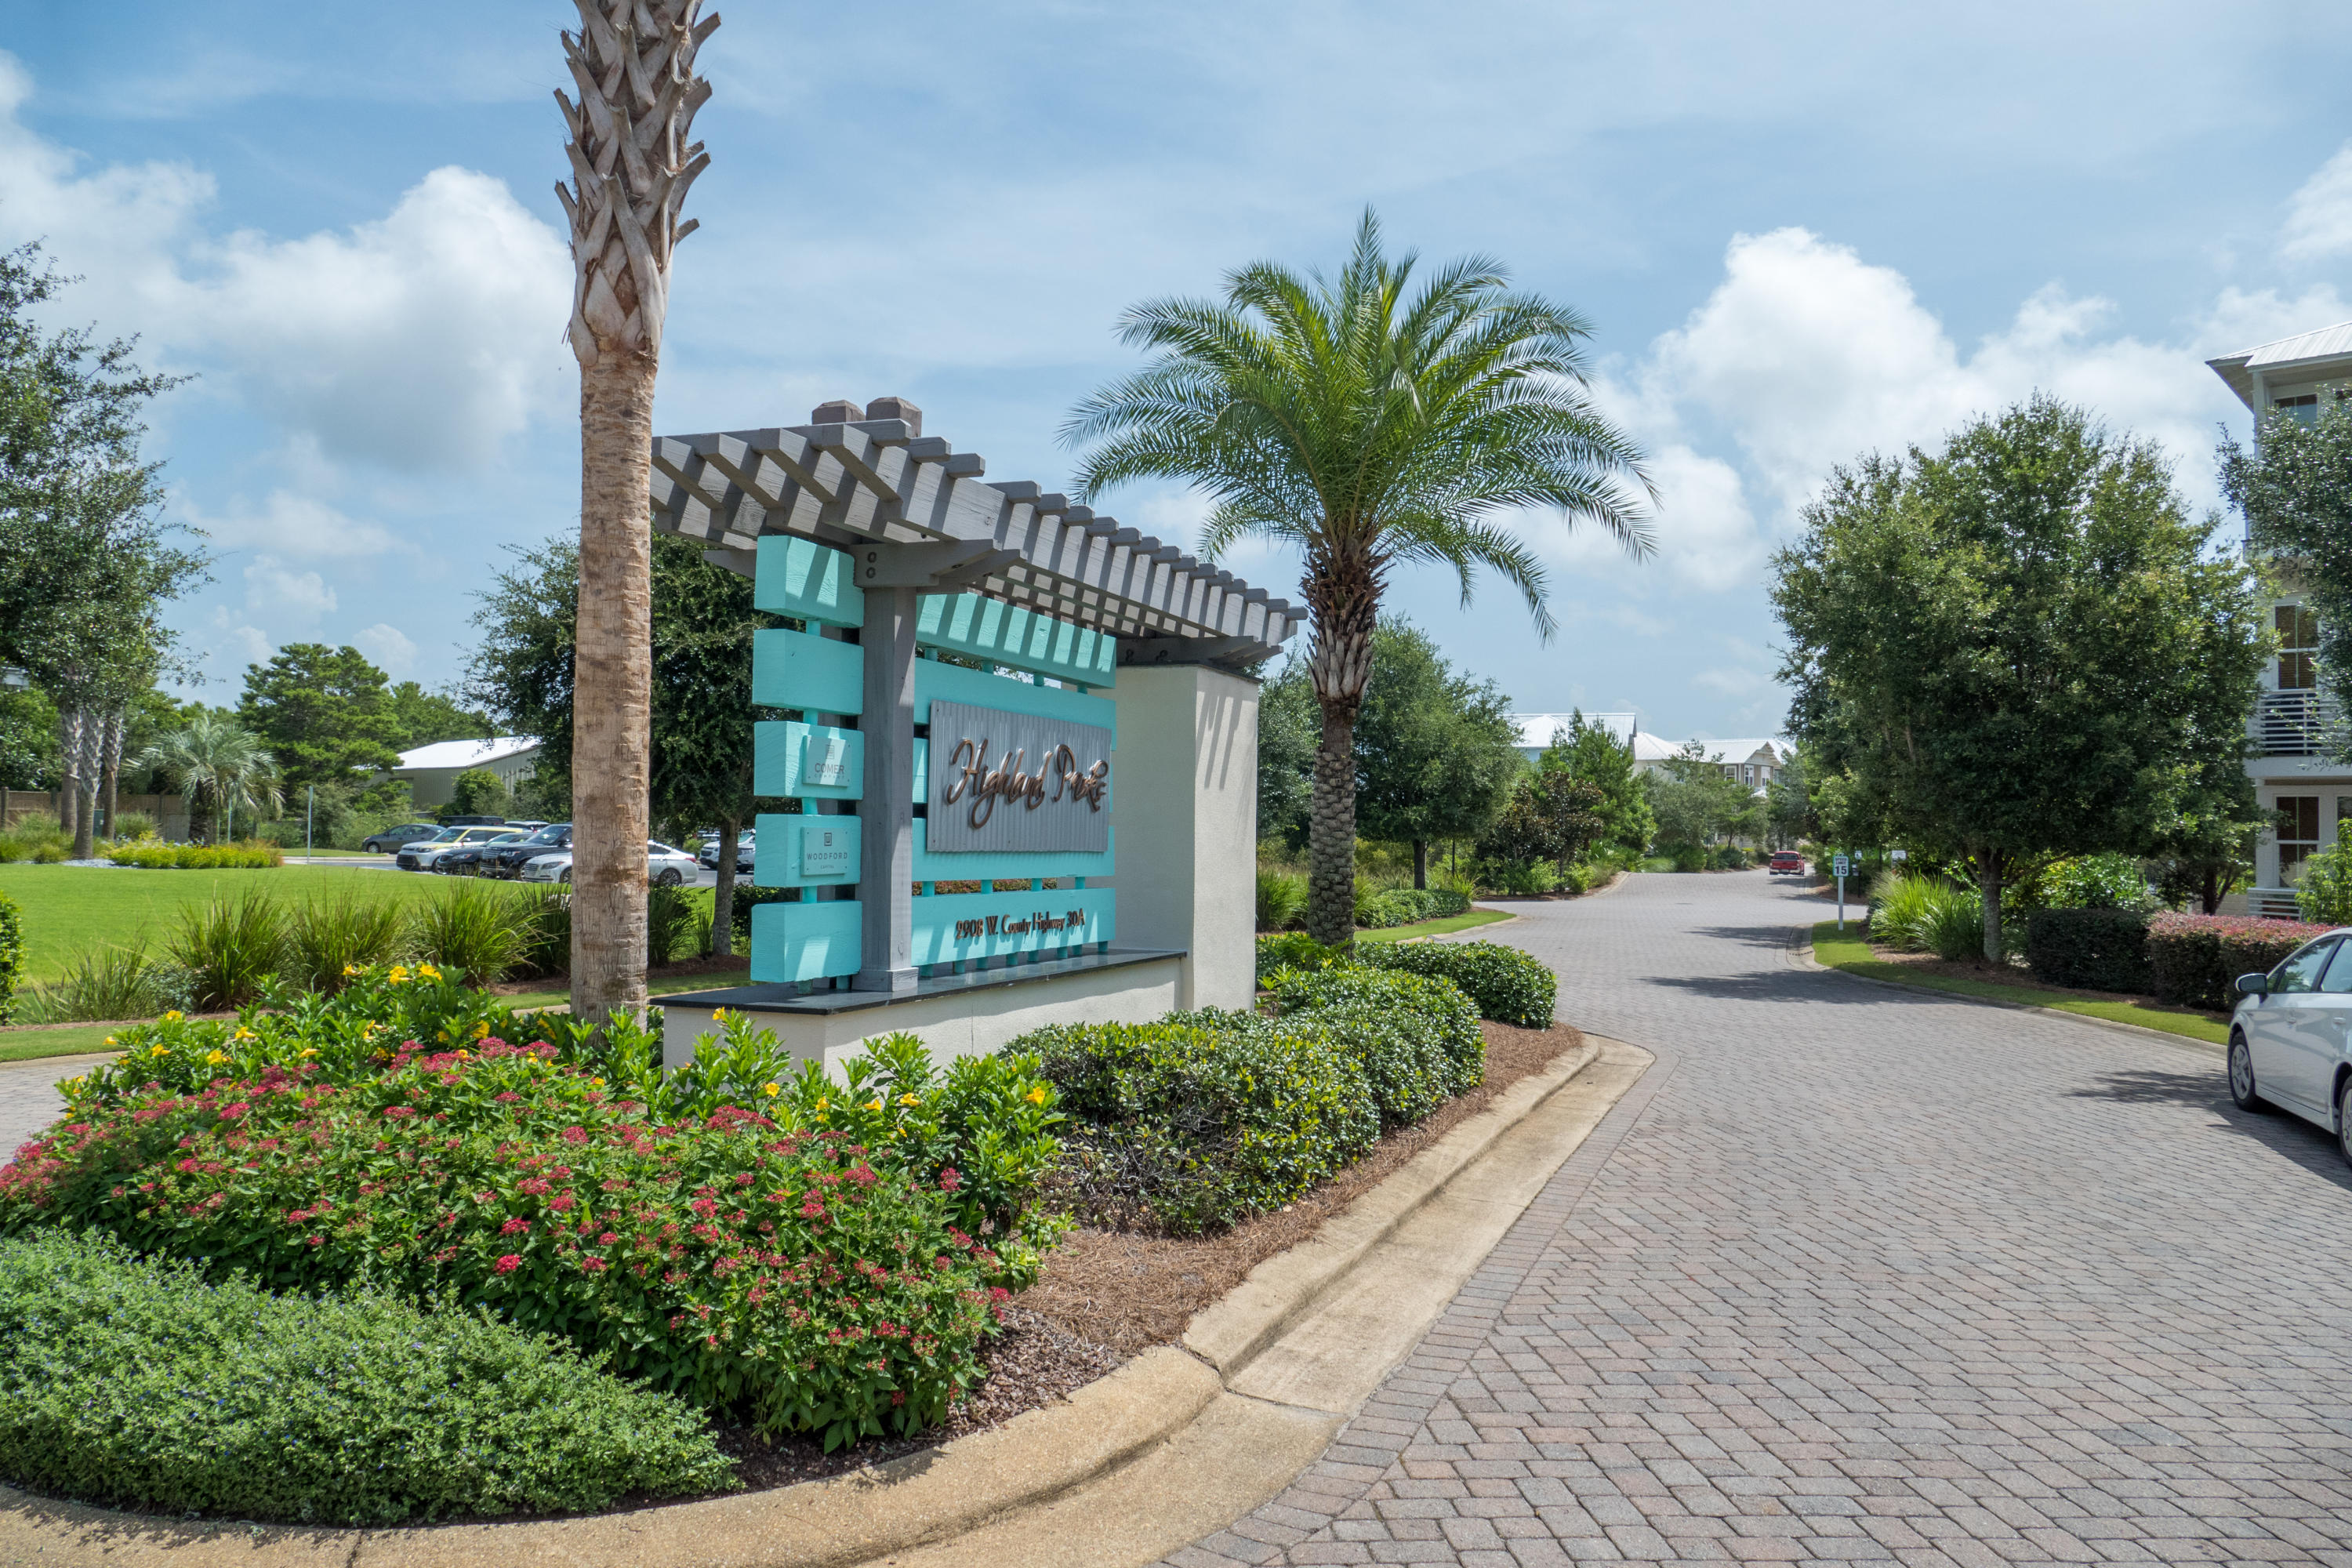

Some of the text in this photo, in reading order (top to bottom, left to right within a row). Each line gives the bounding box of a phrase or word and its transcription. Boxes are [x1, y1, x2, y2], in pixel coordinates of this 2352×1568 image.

[815, 763, 844, 774] COMER
[946, 739, 1108, 829] Highland Park
[1835, 866, 1847, 875] 15
[956, 908, 1086, 939] 2908 W. County Highway 30A
